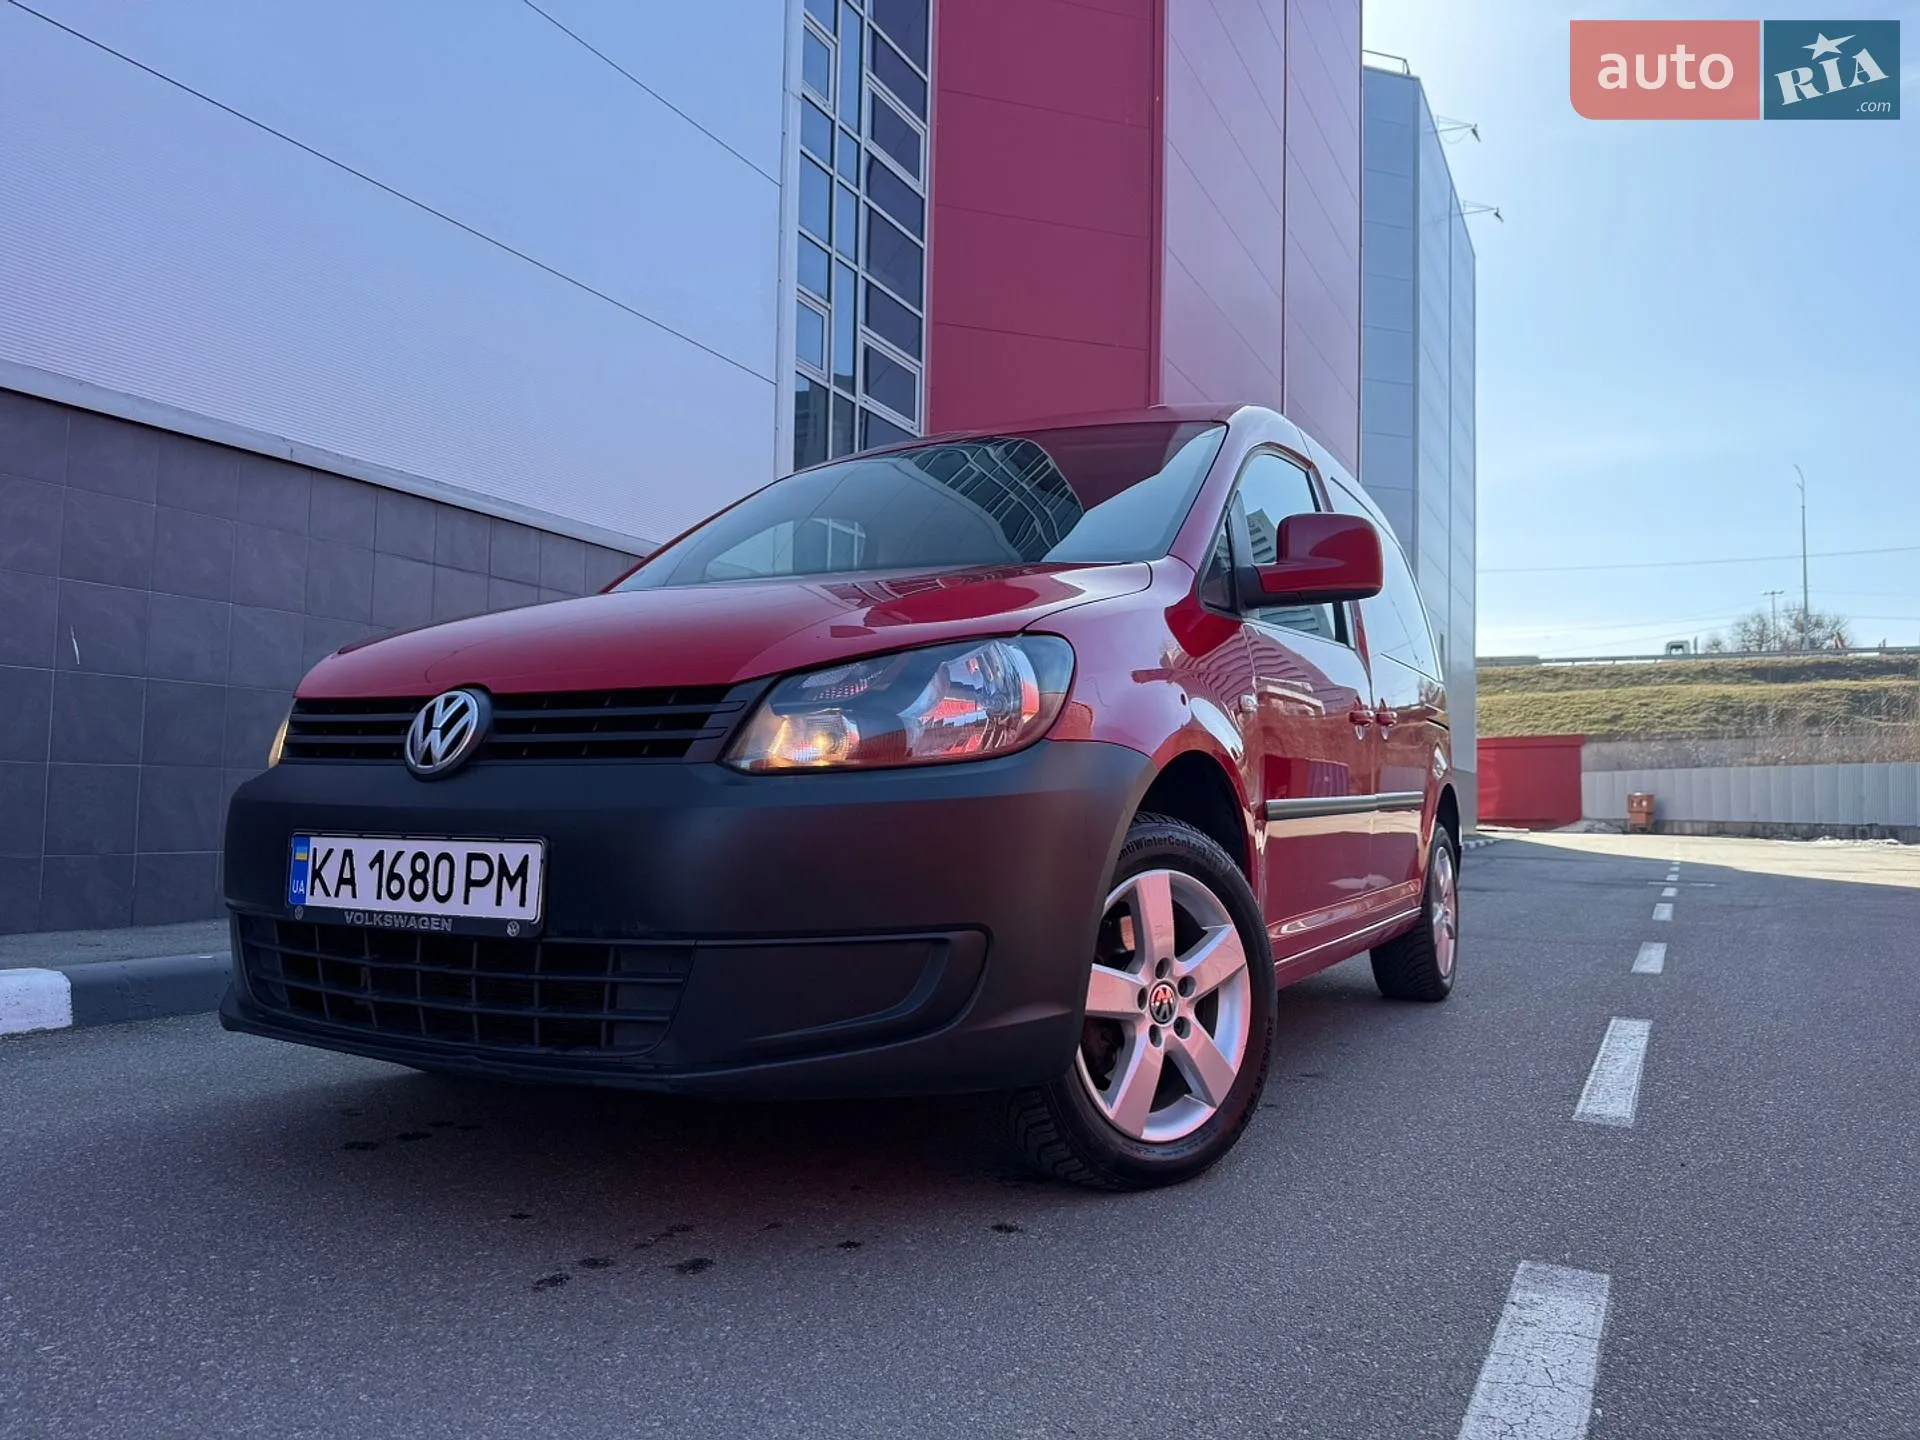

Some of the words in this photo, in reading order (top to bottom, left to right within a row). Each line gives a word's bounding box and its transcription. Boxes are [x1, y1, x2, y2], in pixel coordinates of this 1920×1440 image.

[292, 879, 305, 895] UA
[309, 847, 358, 899] KA
[368, 849, 456, 904] 1680
[463, 852, 530, 908] PM
[344, 910, 453, 932] VOLKSWAGEN
